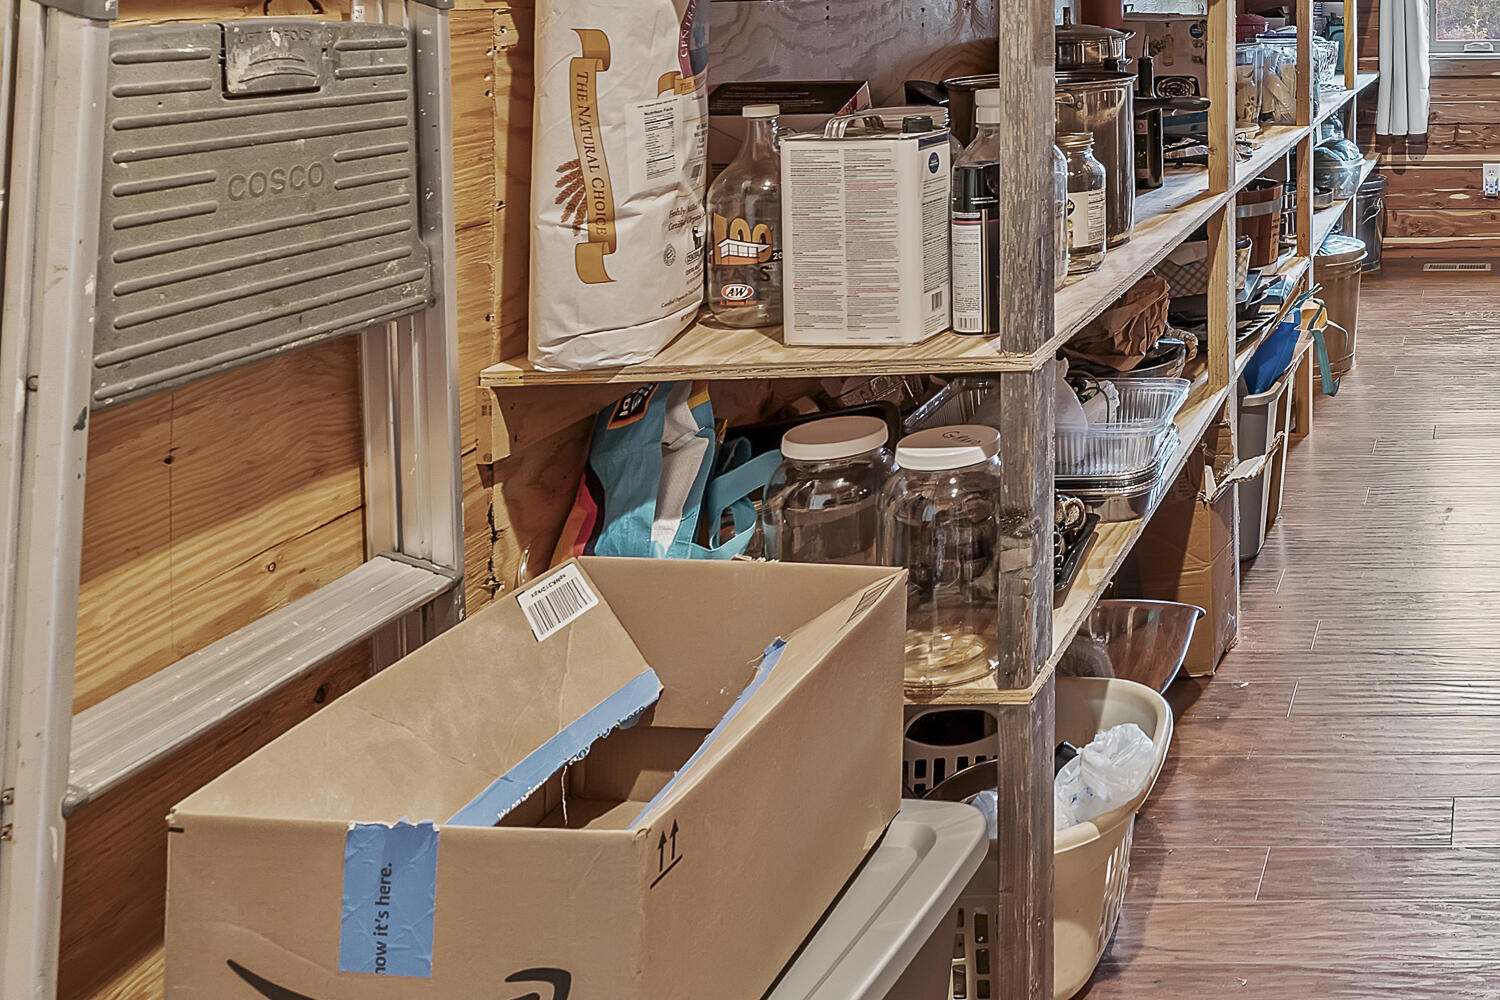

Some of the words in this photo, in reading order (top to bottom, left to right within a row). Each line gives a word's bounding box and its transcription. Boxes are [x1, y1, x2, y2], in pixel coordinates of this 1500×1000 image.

[576, 71, 589, 102] THE
[577, 104, 601, 173] NATURAL
[227, 161, 325, 203] COSCO
[591, 177, 607, 236] CHOICE
[375, 862, 393, 906] here.
[373, 910, 389, 936] it's
[375, 941, 388, 976] now
